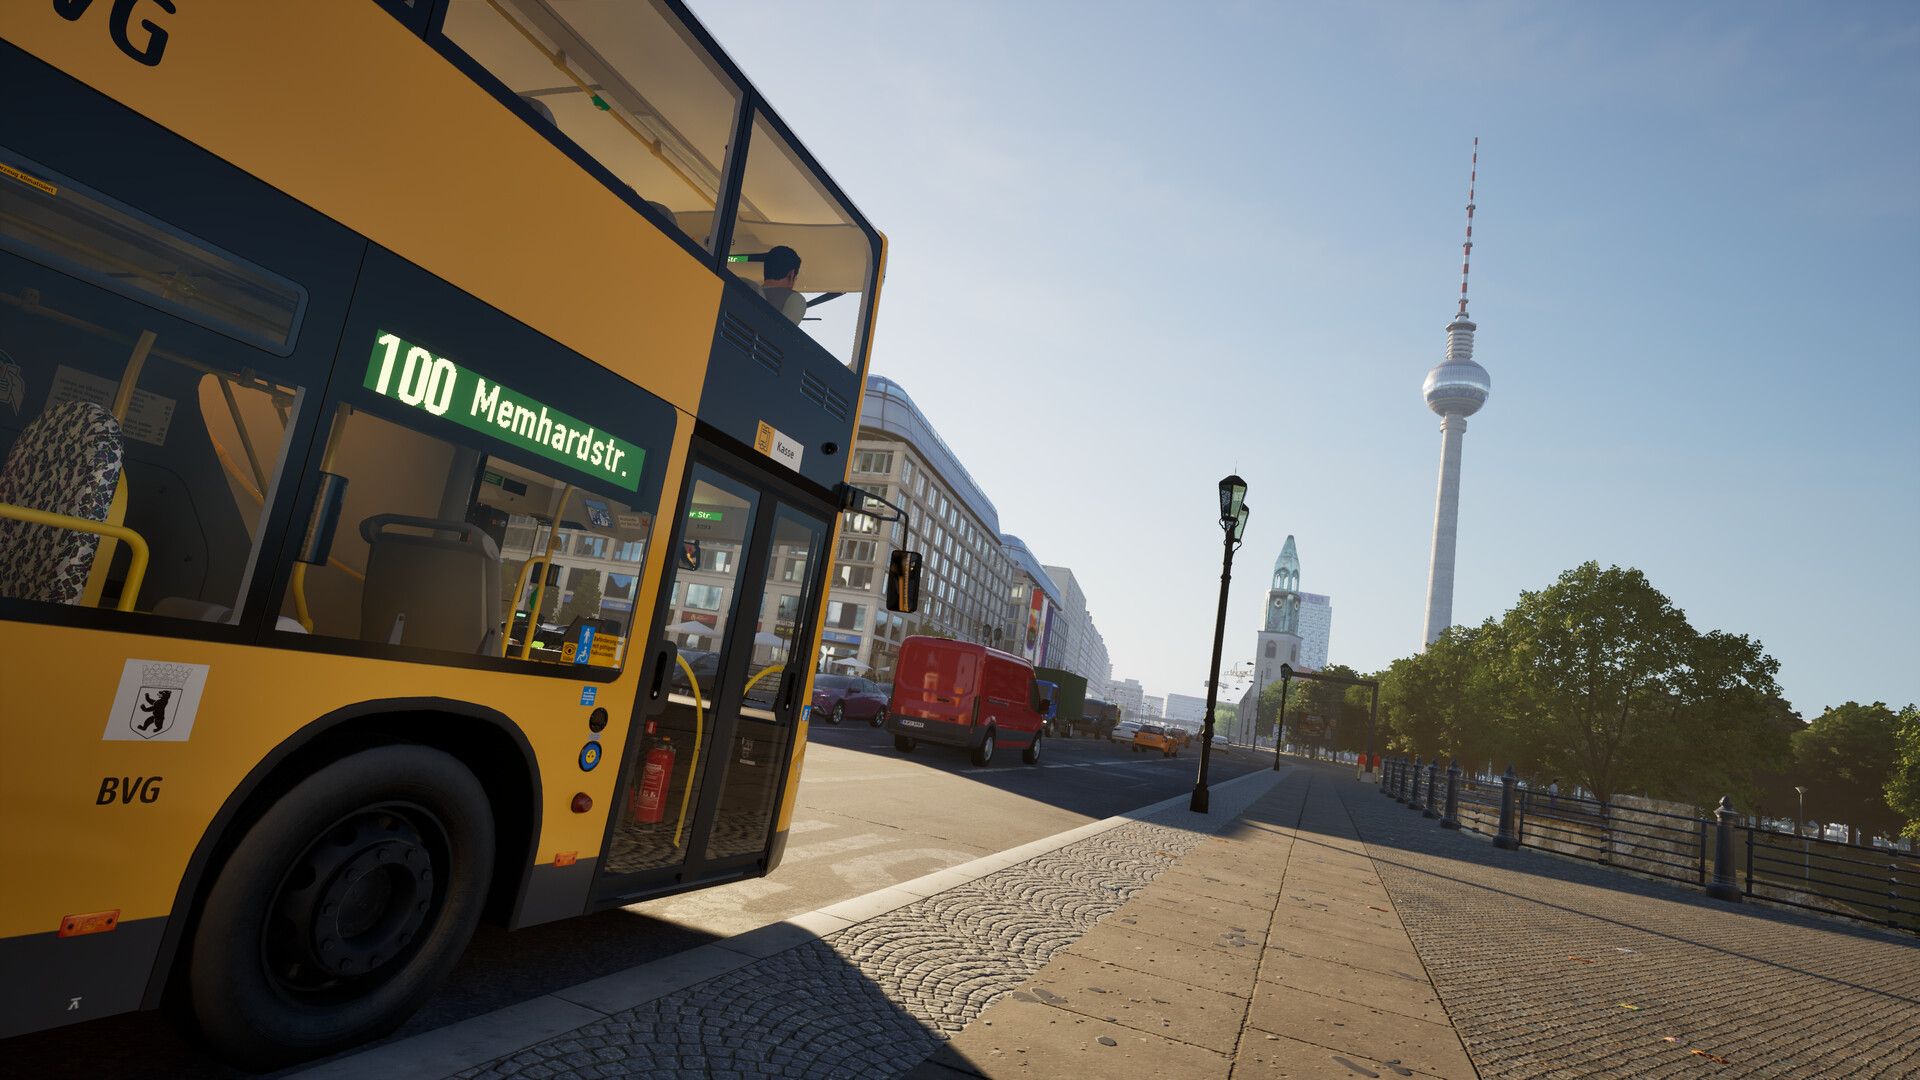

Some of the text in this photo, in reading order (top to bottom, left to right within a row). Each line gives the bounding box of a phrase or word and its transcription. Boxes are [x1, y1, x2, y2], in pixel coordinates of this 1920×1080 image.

[375, 334, 627, 478] 100 Memhardstr.
[776, 441, 795, 460] Kasse
[698, 511, 712, 519] Str.
[95, 776, 163, 806] BVG
